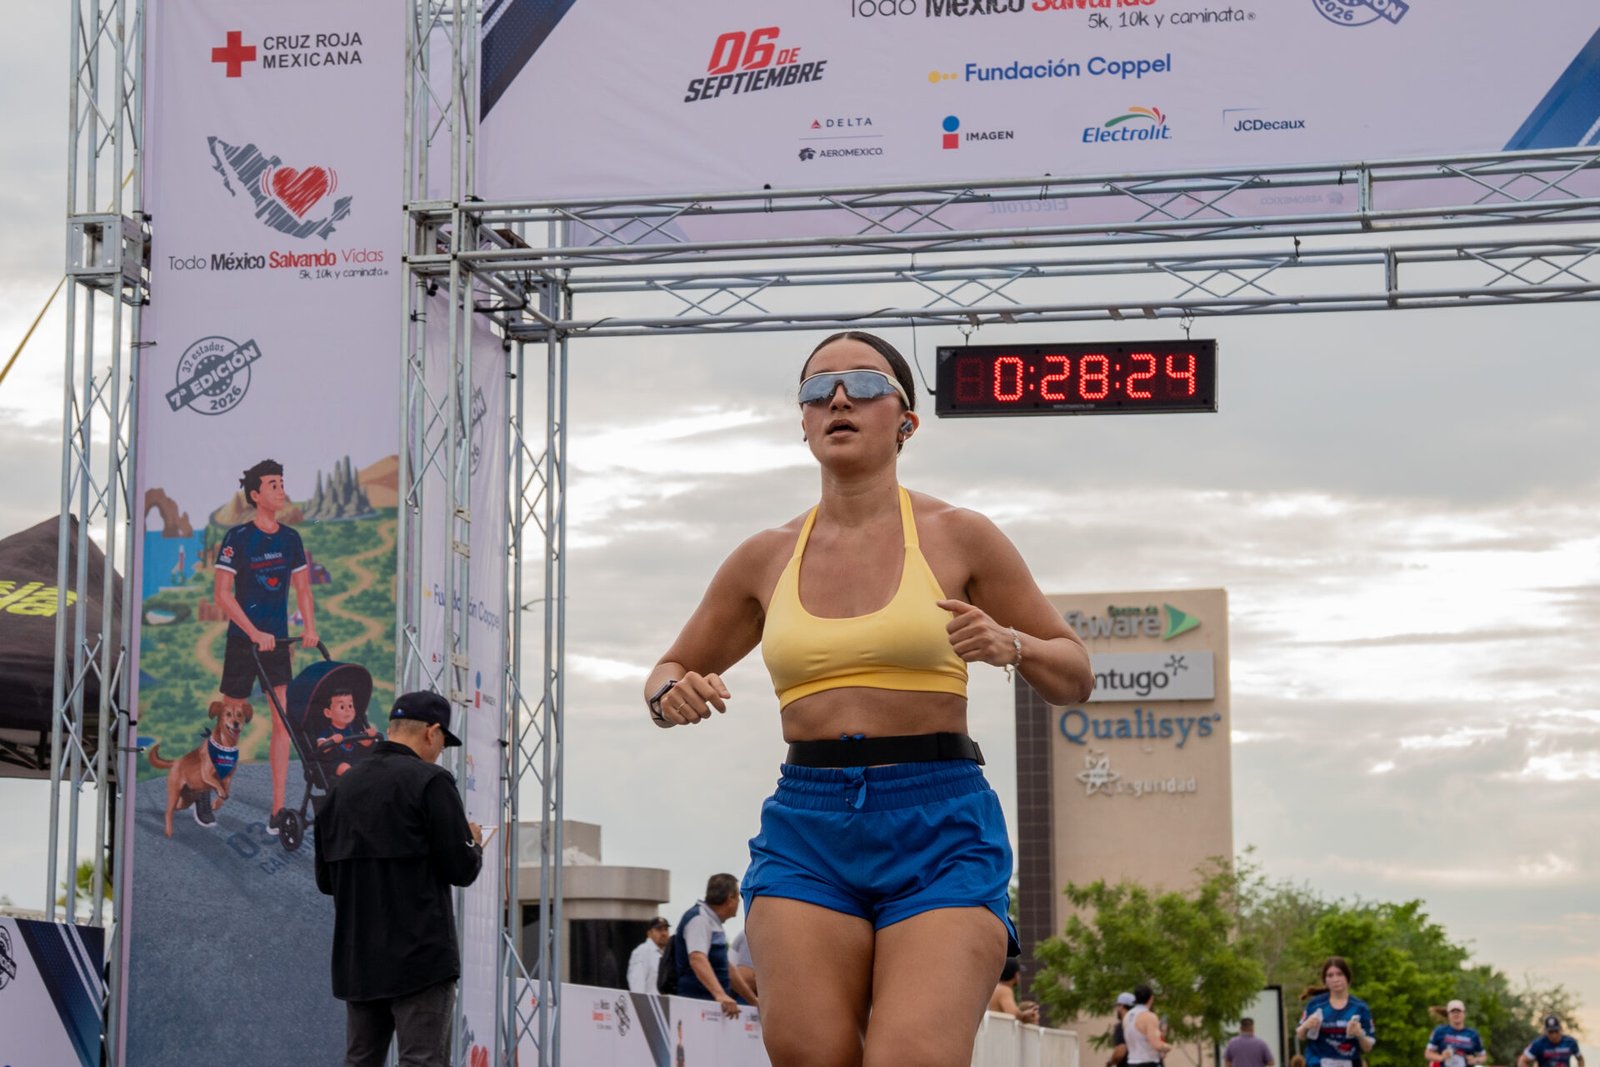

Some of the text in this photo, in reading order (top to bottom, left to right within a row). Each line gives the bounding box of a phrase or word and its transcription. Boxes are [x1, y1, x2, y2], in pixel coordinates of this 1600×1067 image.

[1088, 13, 1113, 31] 5k,
[1119, 11, 1149, 28] 10k
[1155, 13, 1165, 28] y
[263, 32, 363, 50] CRUZ ROJA
[707, 26, 801, 75] 06 DE
[263, 51, 363, 69] MEXICANA
[965, 53, 1171, 82] Fundación Coppel
[684, 60, 828, 103] SEPTIEMBRE
[826, 117, 873, 128] DELTA
[1233, 118, 1306, 132] JCDecaux
[966, 130, 1014, 141] IMAGEN
[1082, 126, 1170, 143] Electrolit
[819, 147, 883, 158] AEROMEXICO
[168, 248, 384, 271] Todo México Salvando Vidas
[182, 341, 225, 373] 32 estados
[994, 354, 1196, 401] 0:28:24
[209, 386, 242, 410] 2026
